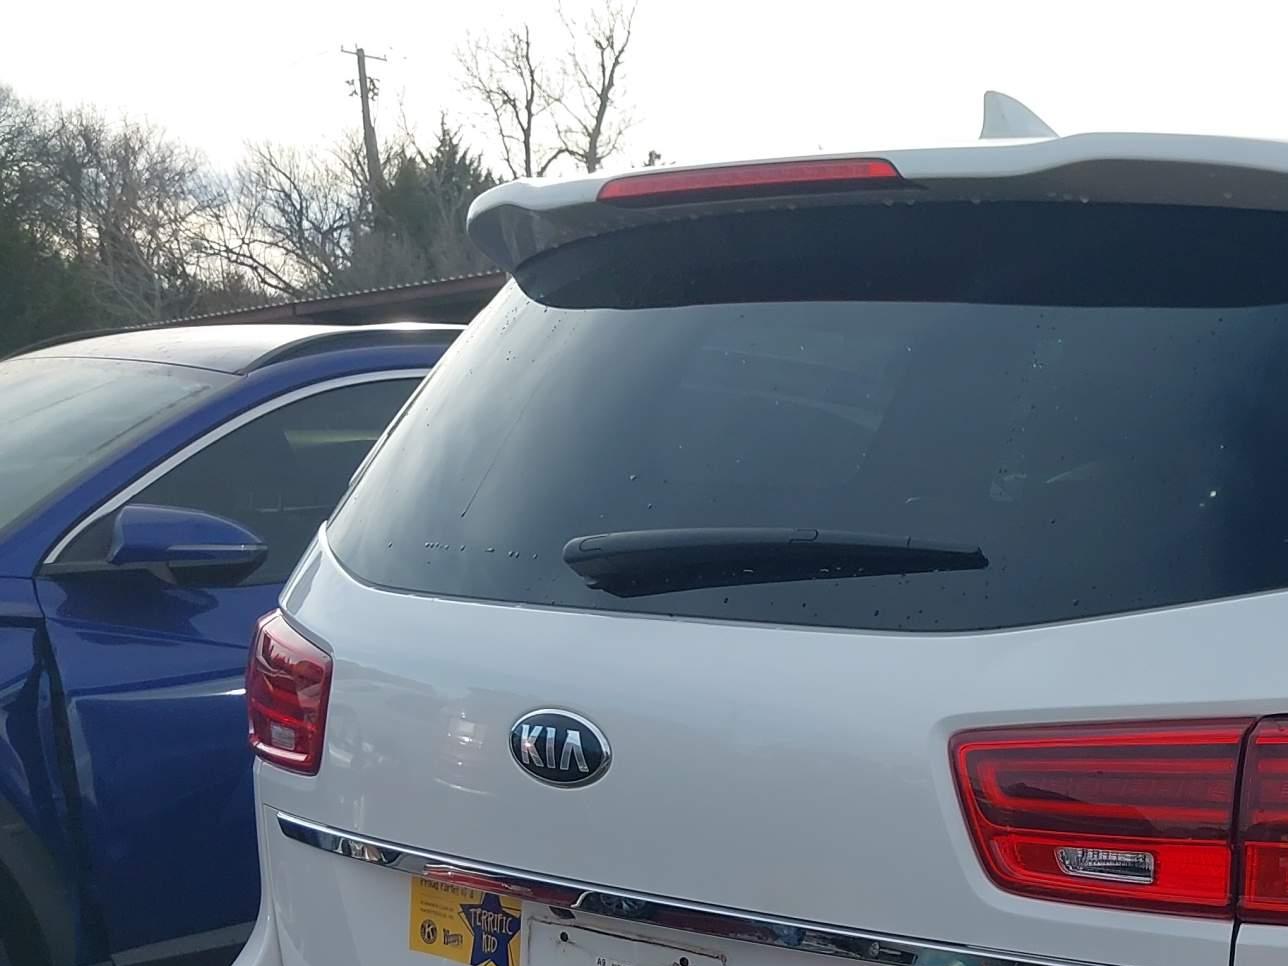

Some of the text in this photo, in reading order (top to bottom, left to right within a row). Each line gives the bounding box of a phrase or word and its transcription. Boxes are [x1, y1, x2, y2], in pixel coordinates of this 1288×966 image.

[520, 723, 590, 773] KIA
[469, 907, 513, 936] TERRIFIC
[482, 931, 498, 954] KID
